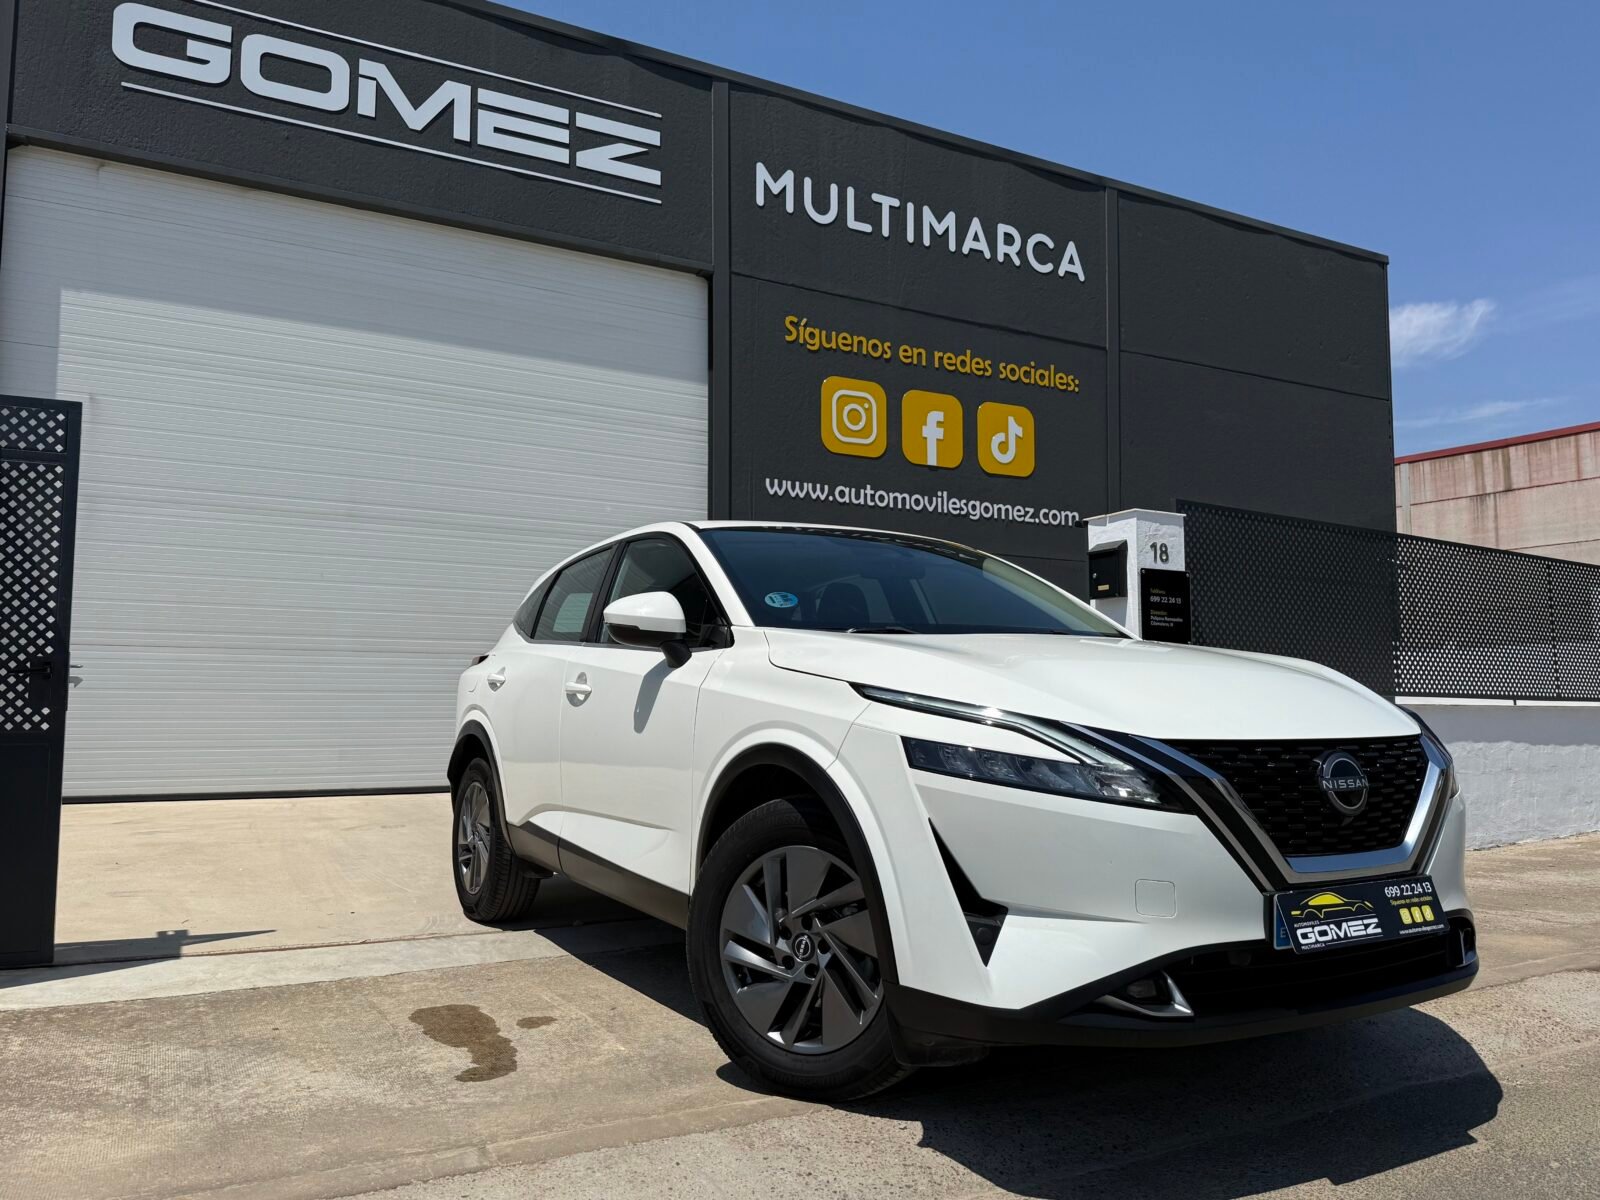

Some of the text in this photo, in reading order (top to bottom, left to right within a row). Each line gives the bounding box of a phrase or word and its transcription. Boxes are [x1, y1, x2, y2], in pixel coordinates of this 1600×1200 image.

[112, 2, 661, 186] GOMEZ
[755, 161, 1086, 282] MULTIMARCA
[784, 315, 1080, 393] Síguenos en redes sociales:
[765, 477, 1079, 527] www.automovilesgomez.com
[1150, 542, 1169, 563] 18
[1322, 778, 1368, 789] NISSAN
[1384, 882, 1432, 898] 699 22 24 13
[1296, 917, 1382, 945] GOMEZ
